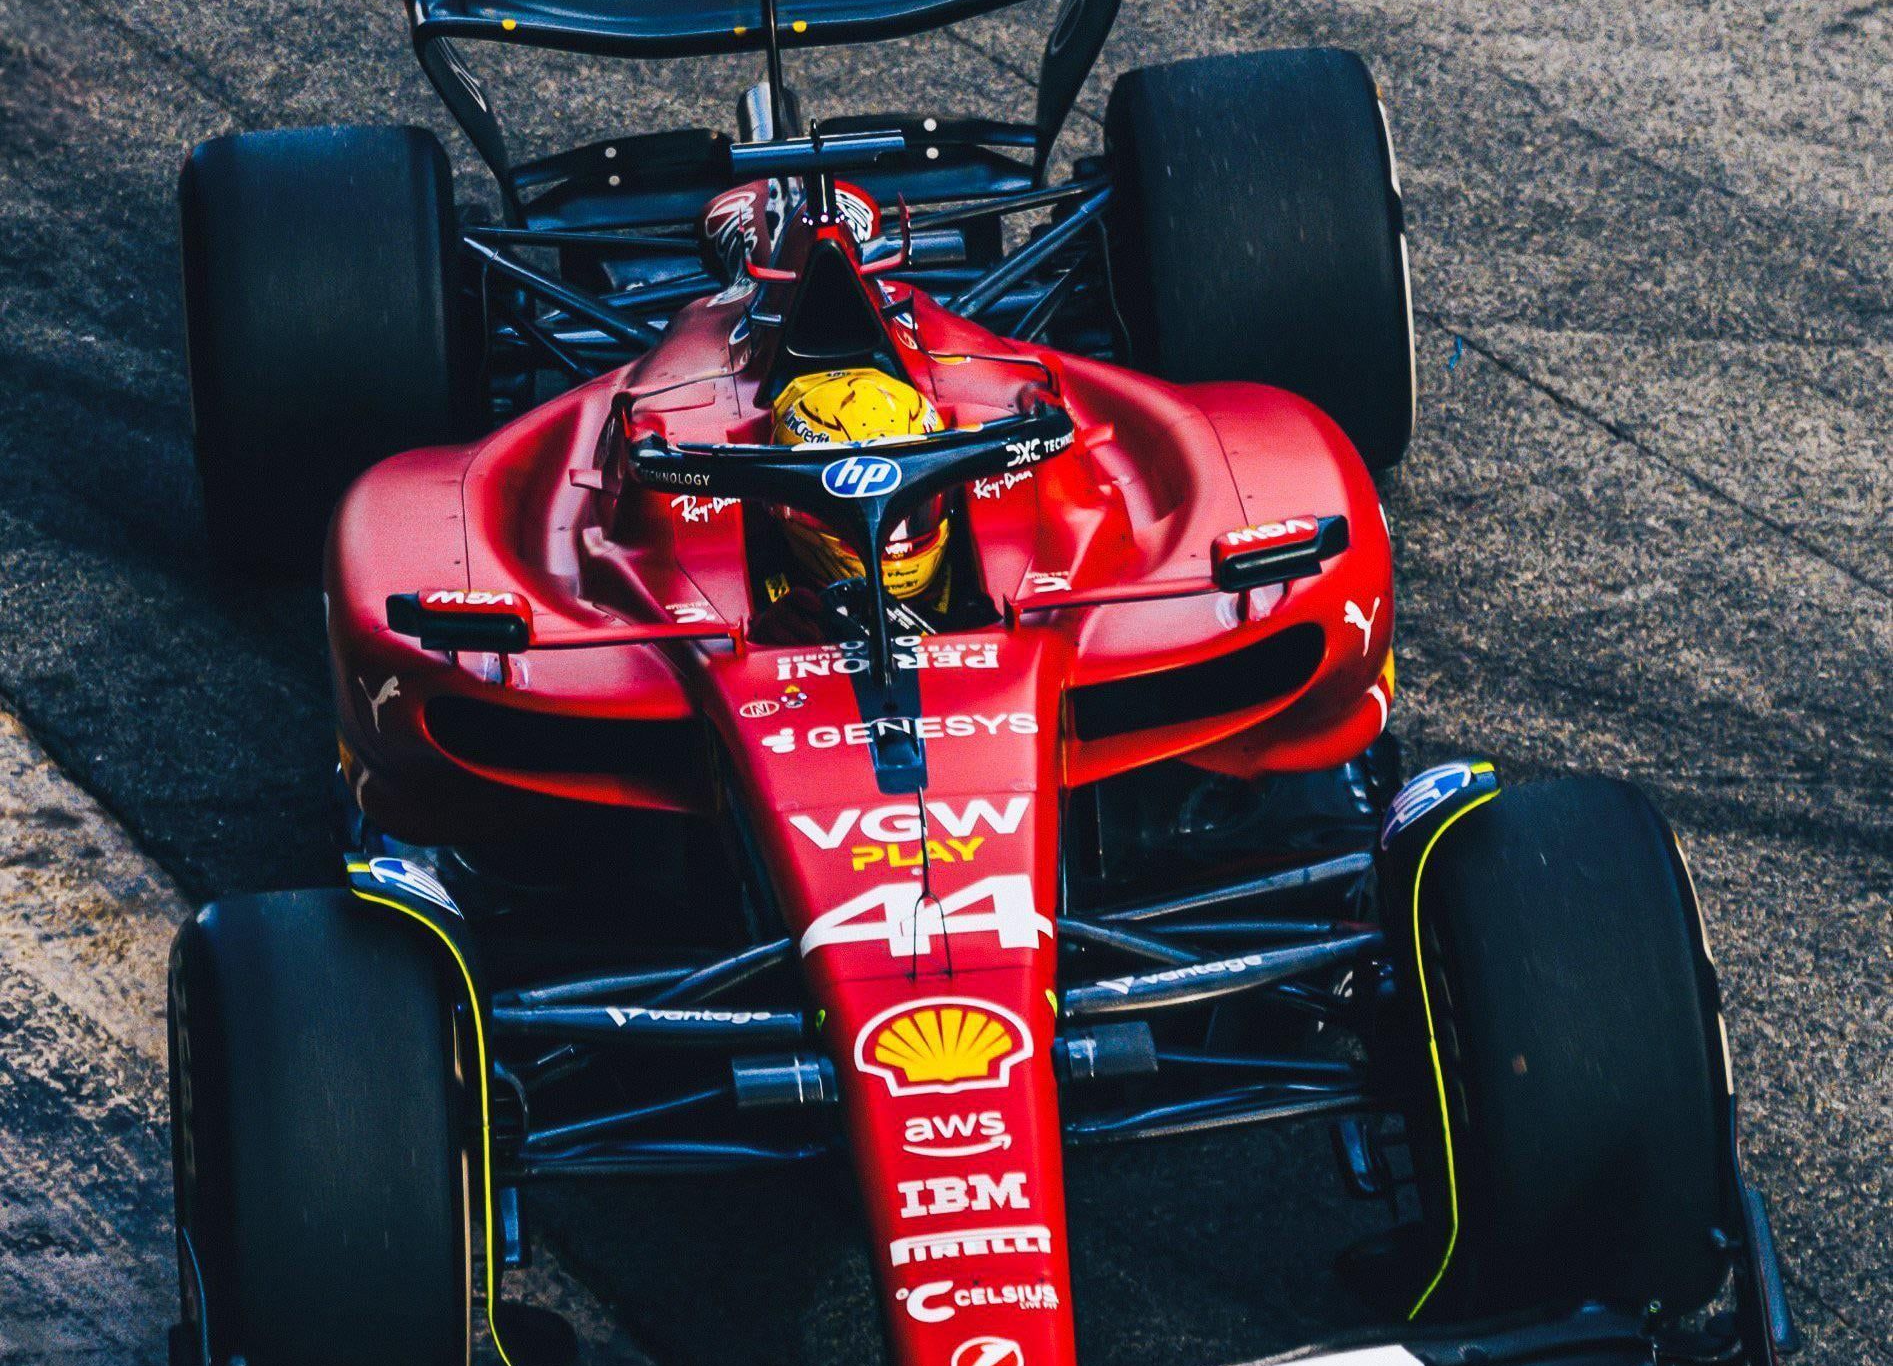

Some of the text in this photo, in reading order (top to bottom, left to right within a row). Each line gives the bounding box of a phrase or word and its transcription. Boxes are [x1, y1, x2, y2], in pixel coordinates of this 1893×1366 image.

[1005, 438, 1041, 467] DXC
[641, 467, 710, 486] HNOLOGY
[833, 457, 892, 497] hp
[776, 648, 999, 681] PERONI
[807, 713, 1039, 749] GENESYS
[788, 797, 1030, 850] VGW
[852, 837, 985, 871] PLAY
[801, 874, 1053, 958] 44
[1140, 954, 1262, 984] vantage
[648, 1009, 772, 1024] vantage
[904, 1110, 1005, 1144] aws
[898, 1173, 1030, 1218] IBM
[889, 1224, 1052, 1267] PIRELLI
[954, 1283, 1059, 1307] CELSIUS
